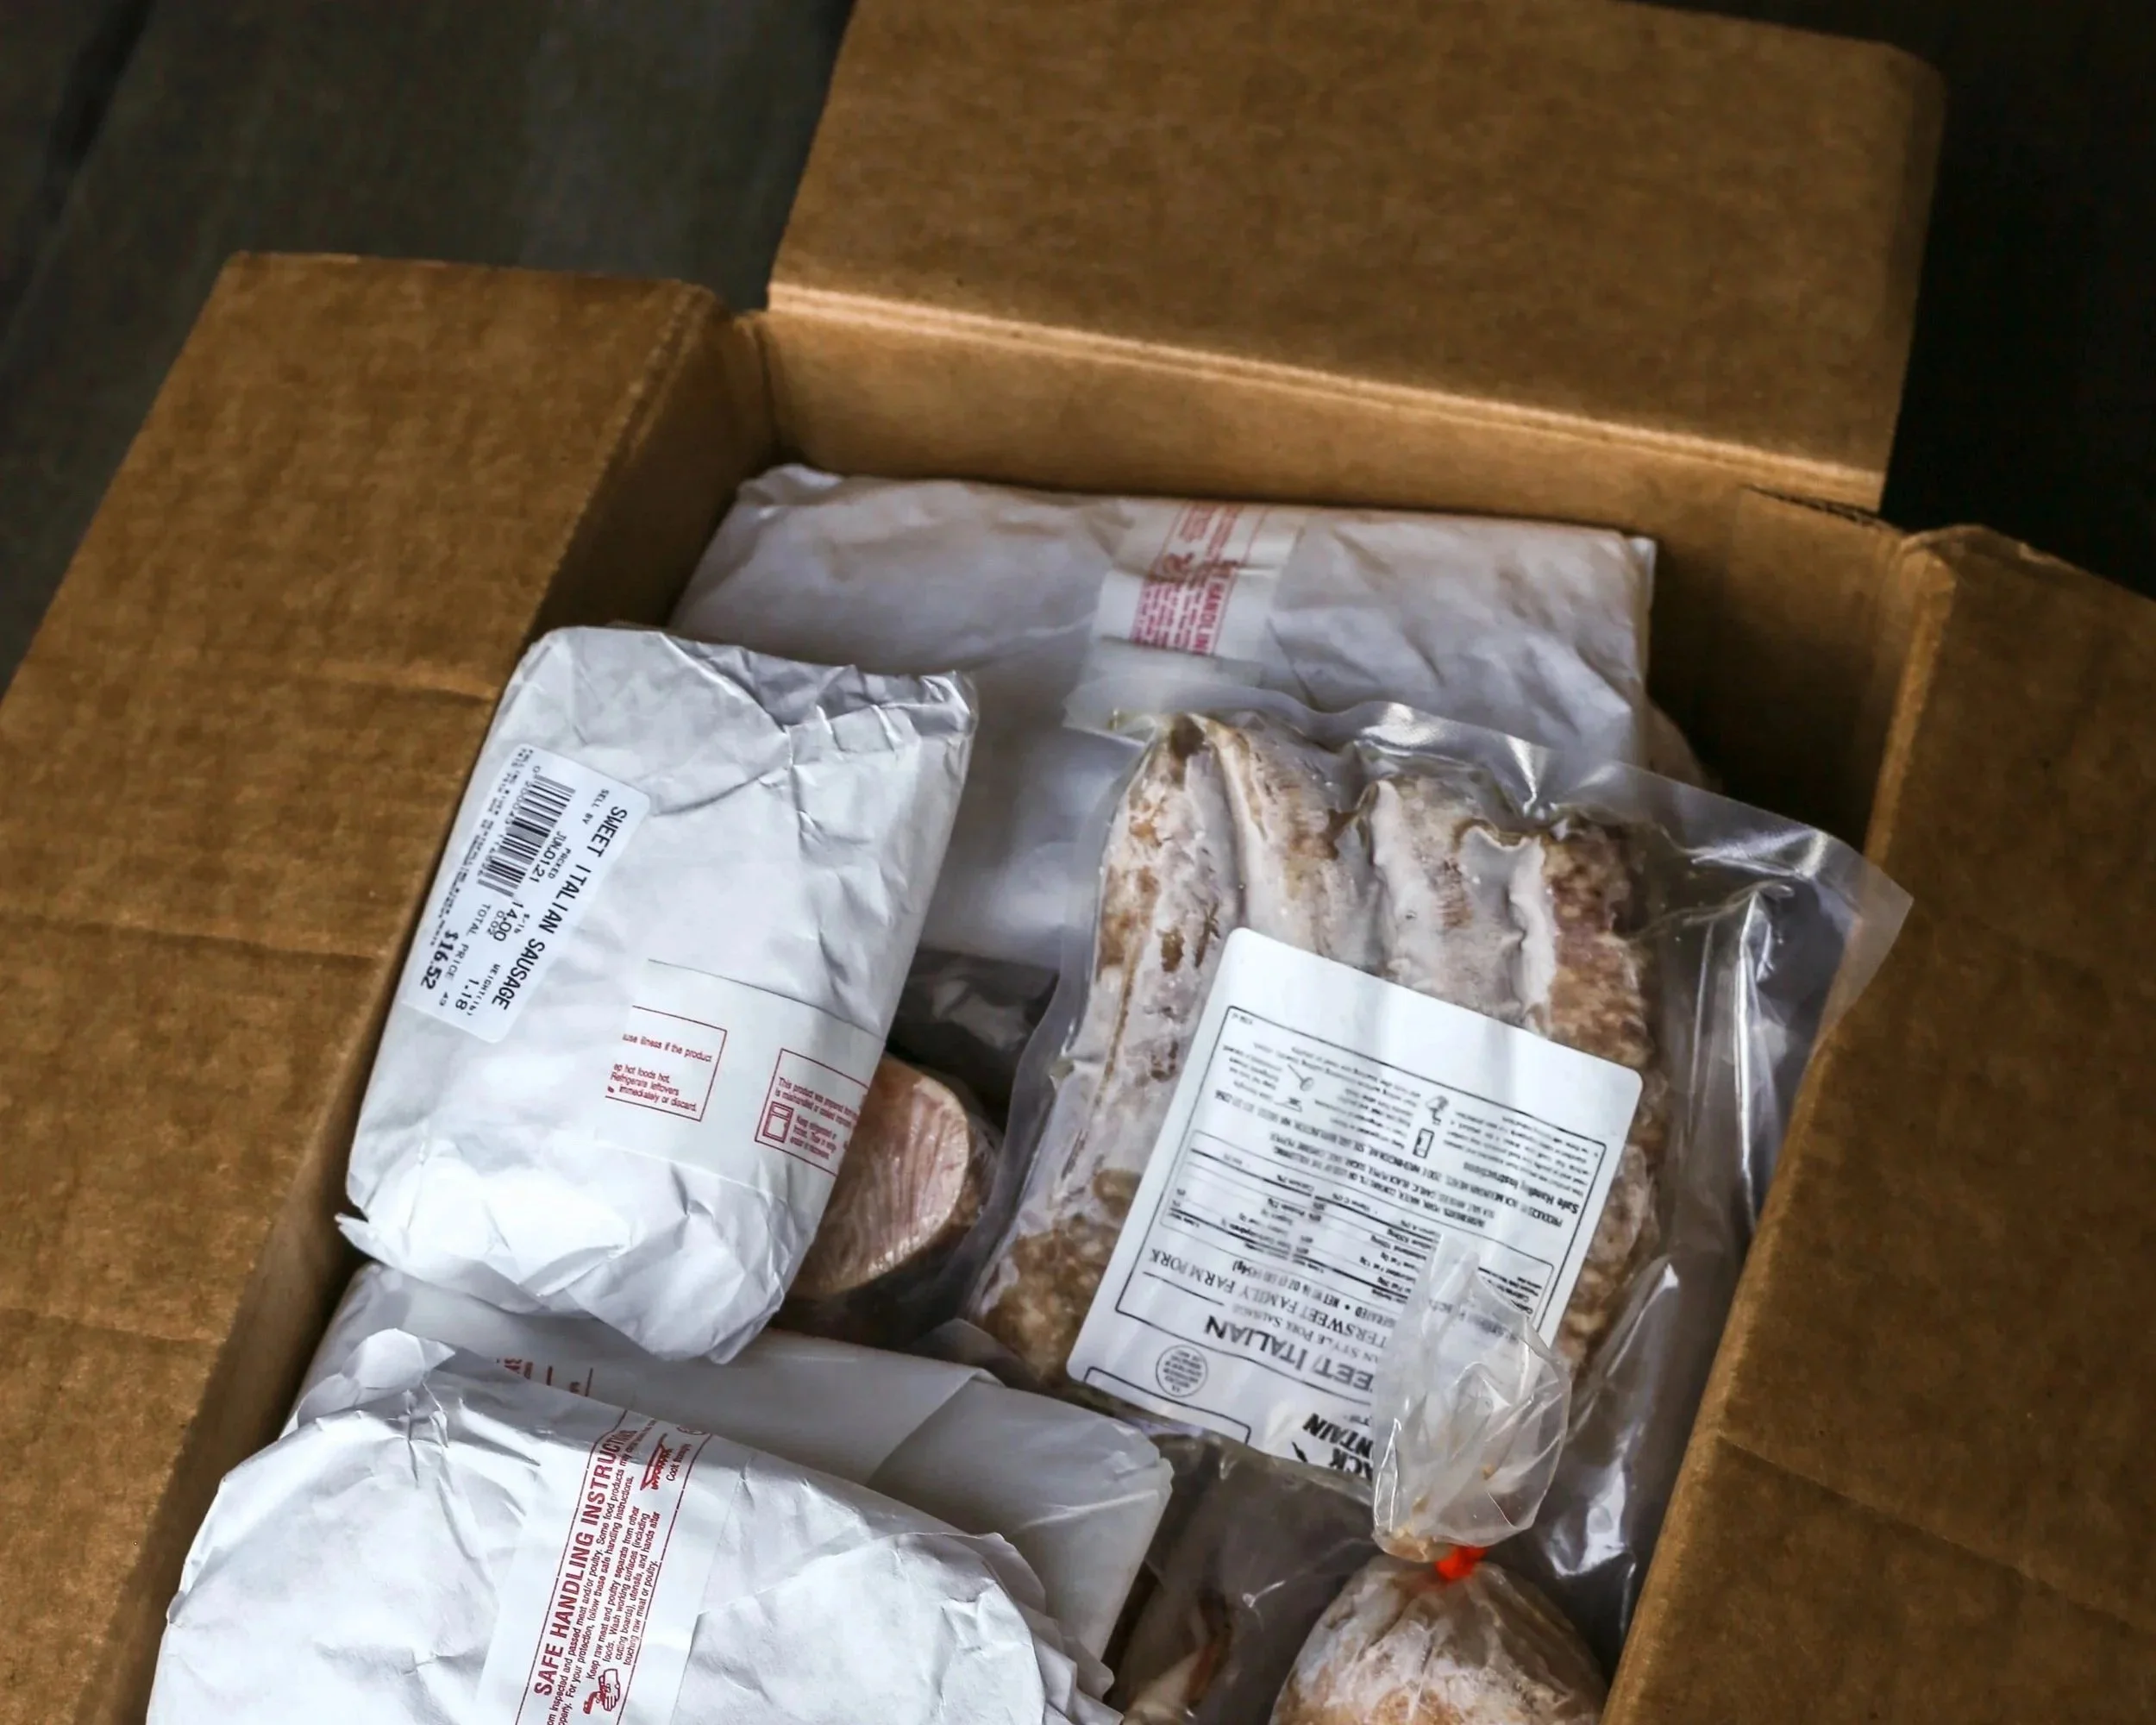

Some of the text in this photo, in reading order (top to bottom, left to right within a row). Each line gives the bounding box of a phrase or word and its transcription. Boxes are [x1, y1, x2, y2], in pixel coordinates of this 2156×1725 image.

[580, 787, 610, 825] SELL BY
[529, 830, 567, 883] JUN.01.21
[547, 846, 572, 880] PACKED
[490, 804, 629, 1010] SWEET ITALIAN SAUSAGE
[492, 900, 523, 943] 14.00
[443, 901, 491, 980] TOTAL PRICE
[418, 928, 461, 990] $16.52
[454, 978, 479, 1011] 1.18
[670, 1043, 683, 1054] the
[684, 1046, 712, 1064] product
[624, 1063, 636, 1074] hot
[636, 1066, 656, 1080] foods
[777, 1076, 793, 1089] This
[661, 1095, 668, 1104] or
[1554, 1197, 1580, 1214] Safe
[1200, 1314, 1309, 1371] ITALIAN
[605, 1467, 626, 1502] products
[665, 1462, 680, 1482] Cook
[601, 1502, 615, 1520] food
[594, 1521, 611, 1546] Some
[602, 1521, 623, 1554] handling
[586, 1546, 605, 1577] poultry.
[598, 1555, 611, 1573] safe
[546, 1529, 598, 1639] HANDLING
[578, 1577, 595, 1604] and/or
[586, 1505, 641, 1680] Keep raw meat and poultry separate from other
[591, 1573, 606, 1596] these
[601, 1512, 650, 1662] foods. Wash working surfaces (including
[612, 1510, 661, 1661] cutting boards), utensils, and hands after
[573, 1605, 587, 1626] meat
[585, 1597, 600, 1621] follow
[620, 1559, 659, 1665] touching raw meat or poultry.
[564, 1627, 583, 1656] passed
[573, 1622, 596, 1664] protection,
[530, 1641, 565, 1697] SAFE
[560, 1657, 573, 1673] and
[569, 1665, 584, 1683] your
[548, 1673, 569, 1712] inspected
[564, 1683, 577, 1698] For
